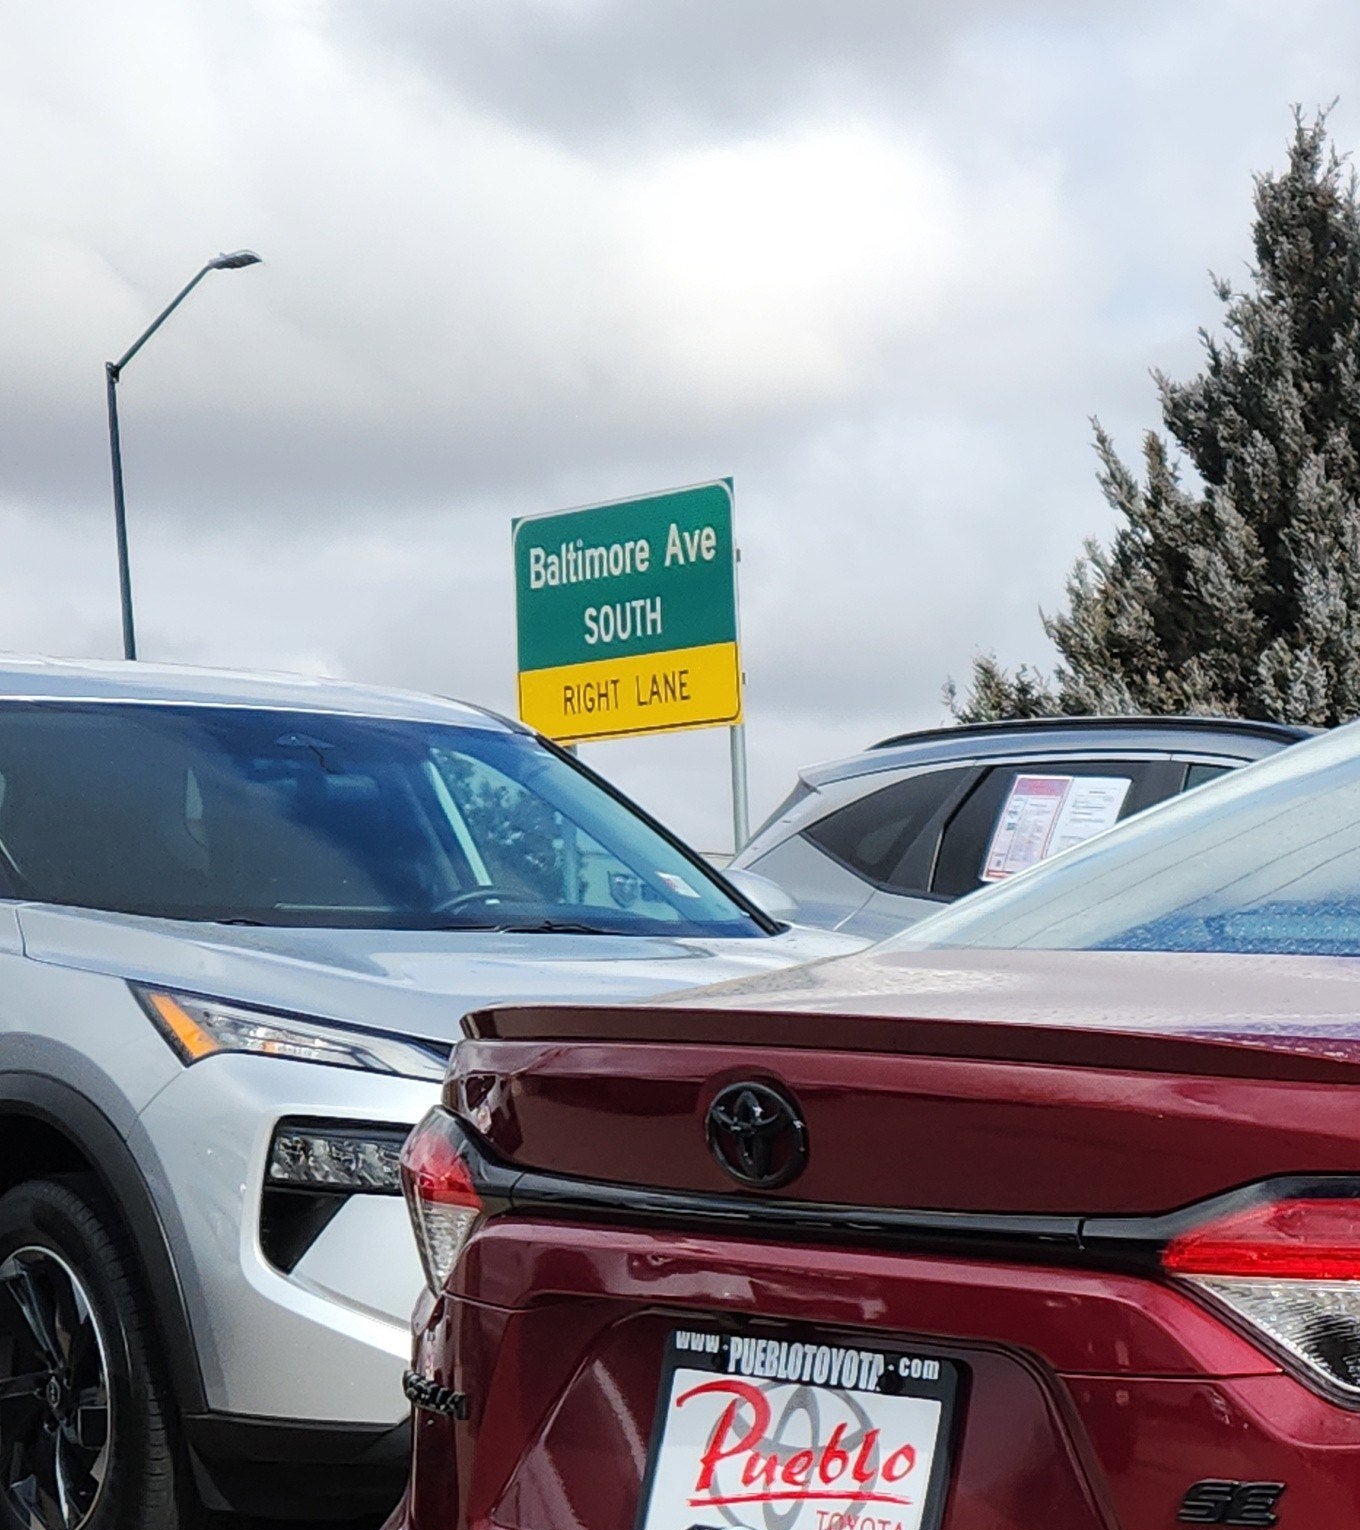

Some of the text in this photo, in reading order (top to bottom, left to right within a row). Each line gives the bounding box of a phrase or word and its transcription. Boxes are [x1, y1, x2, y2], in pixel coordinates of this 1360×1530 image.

[529, 522, 717, 590] Baltimore Ave
[584, 596, 663, 645] SOUTH
[563, 669, 692, 716] RIGHT LANE
[675, 1378, 918, 1493] Pueblo
[1177, 1477, 1286, 1527] SE
